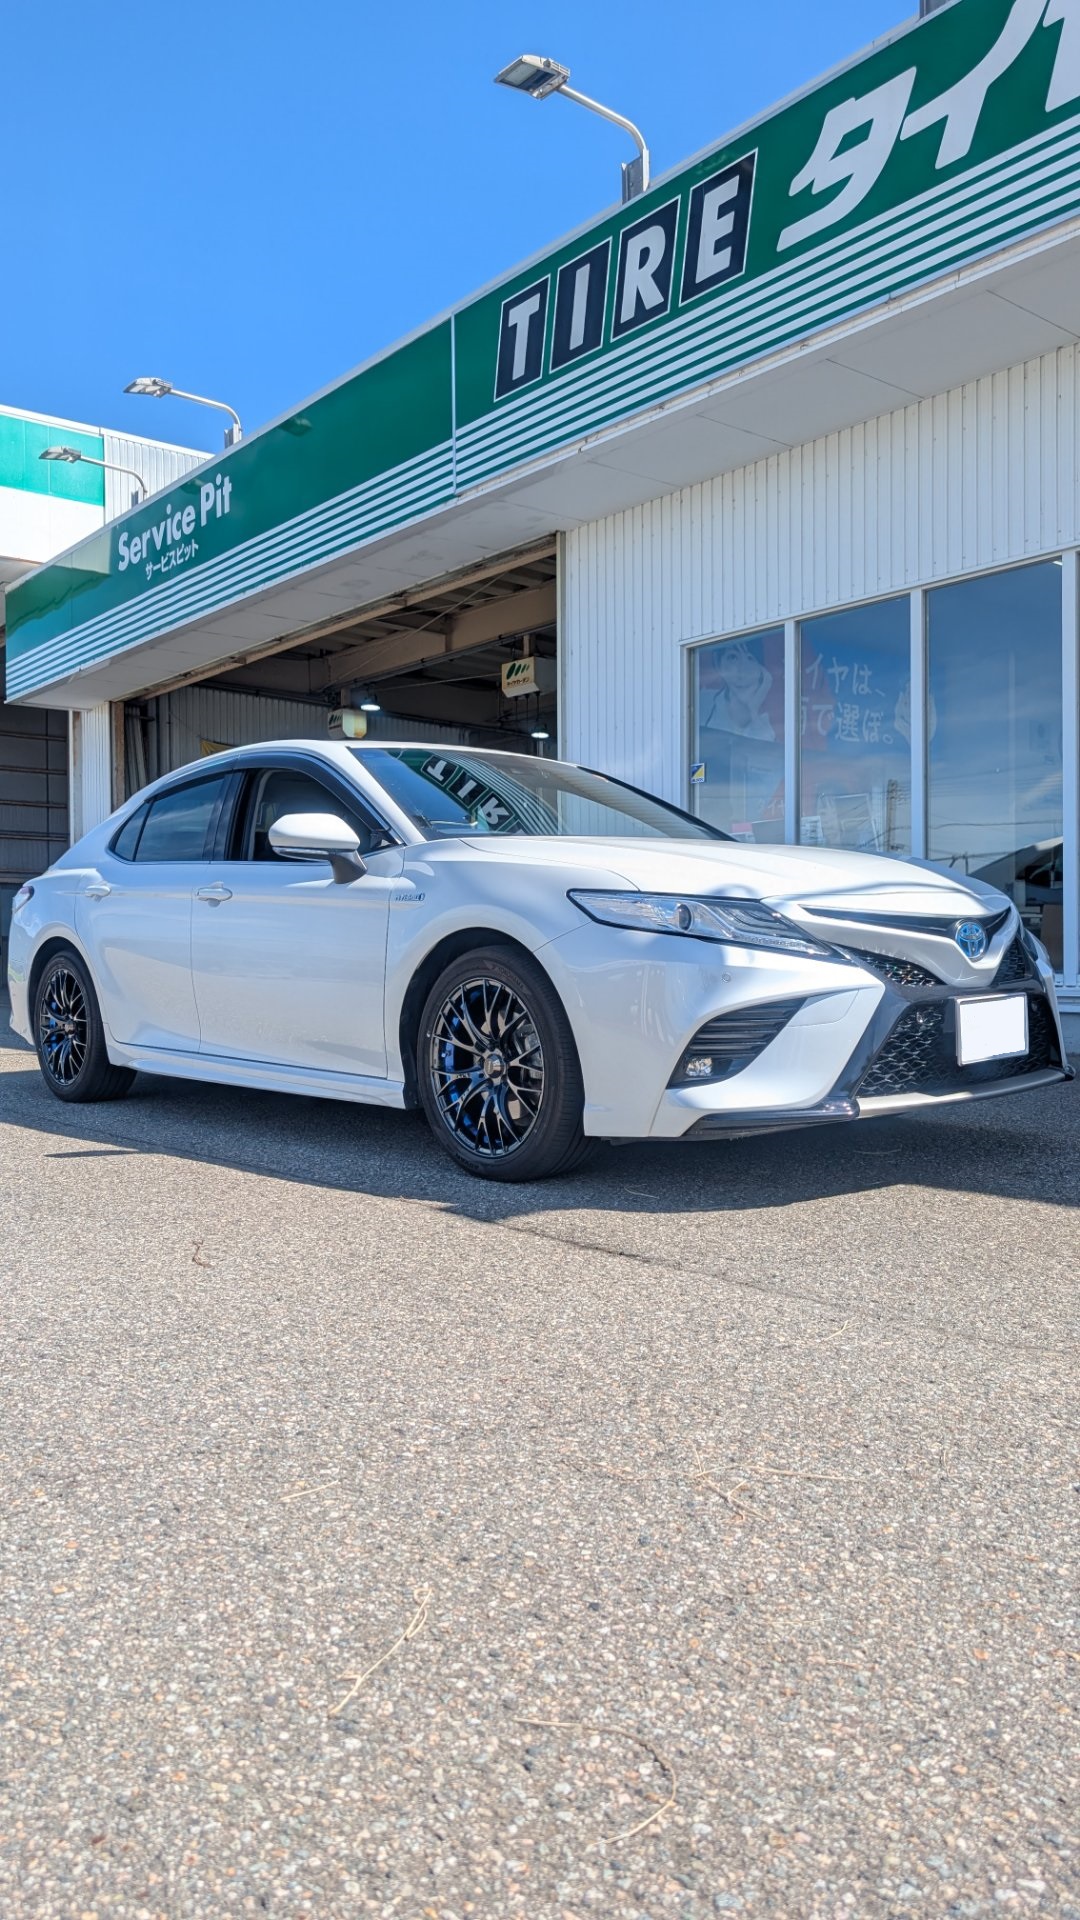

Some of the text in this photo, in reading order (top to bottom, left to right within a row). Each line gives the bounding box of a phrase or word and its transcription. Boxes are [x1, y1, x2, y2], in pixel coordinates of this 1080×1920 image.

[508, 175, 740, 380] TIRE
[118, 473, 232, 572] Service Pit
[145, 538, 199, 580] サービスピット
